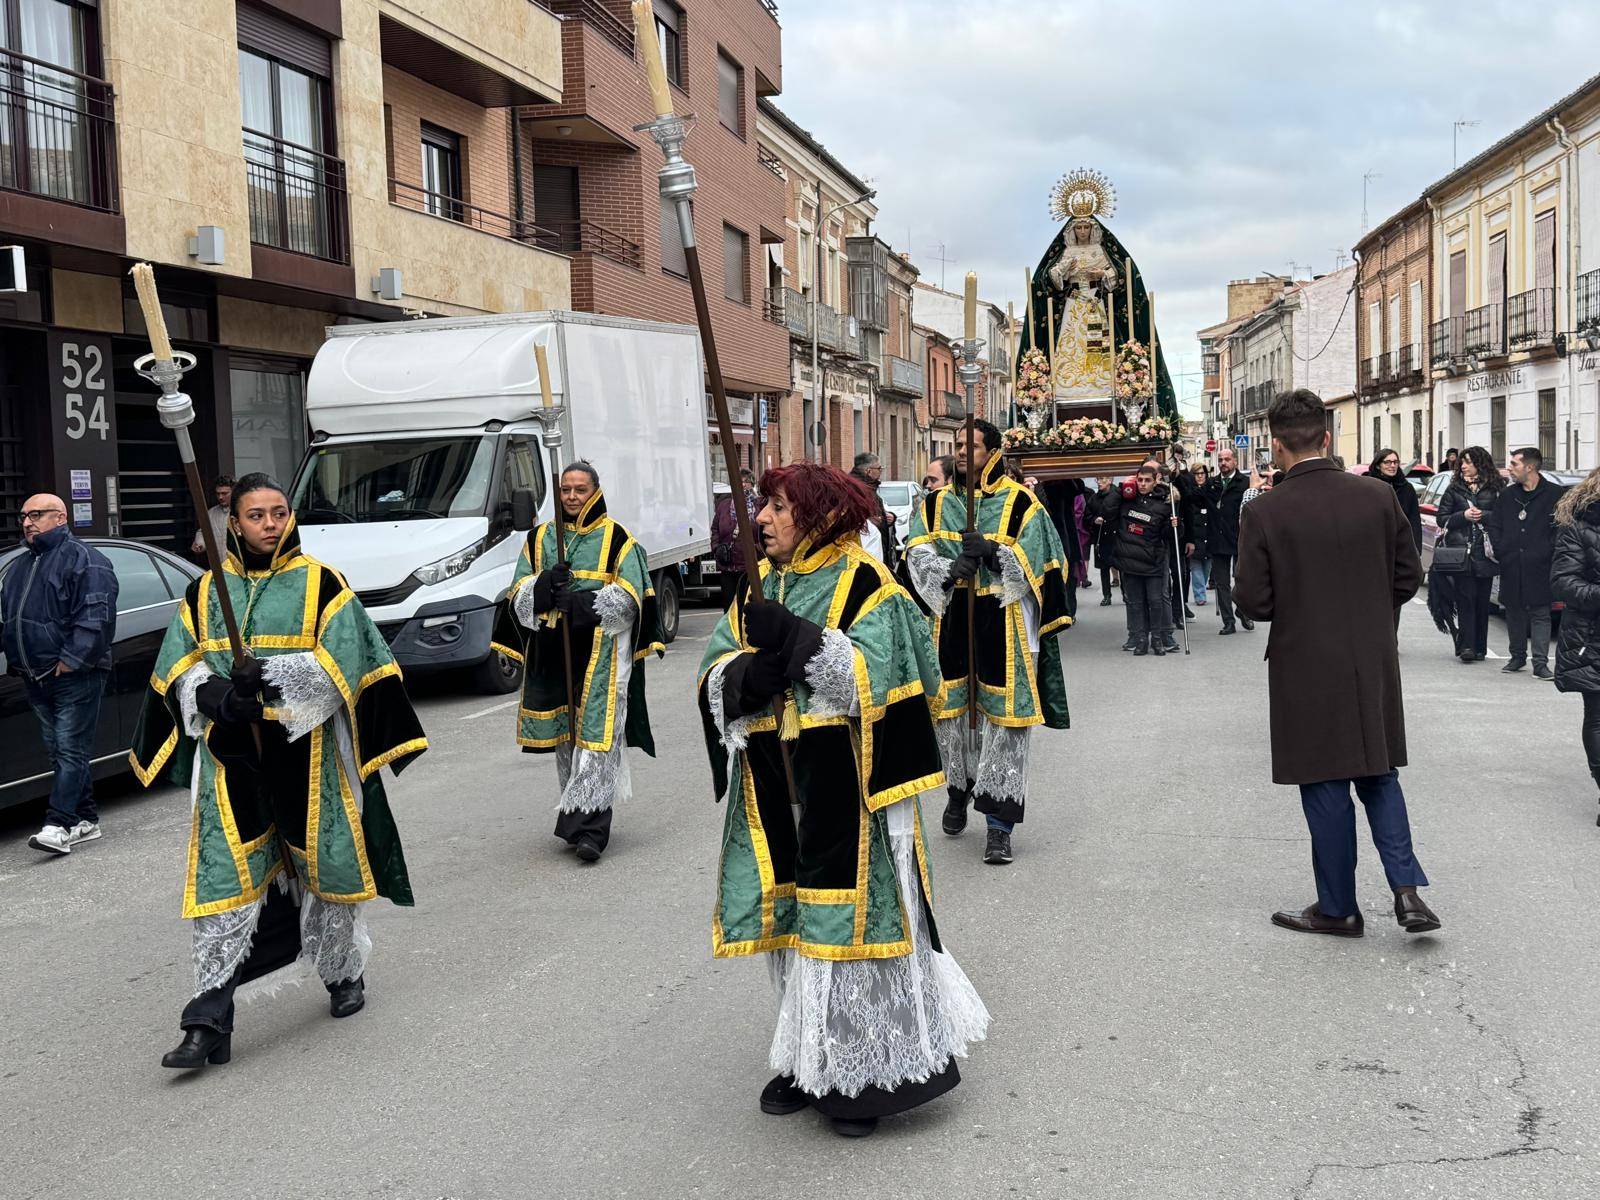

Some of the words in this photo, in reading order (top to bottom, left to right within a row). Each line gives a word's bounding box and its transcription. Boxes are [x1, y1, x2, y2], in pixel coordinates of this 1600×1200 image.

[62, 342, 106, 390] 52
[1467, 369, 1522, 393] RESTAURANTE
[65, 393, 110, 441] 54
